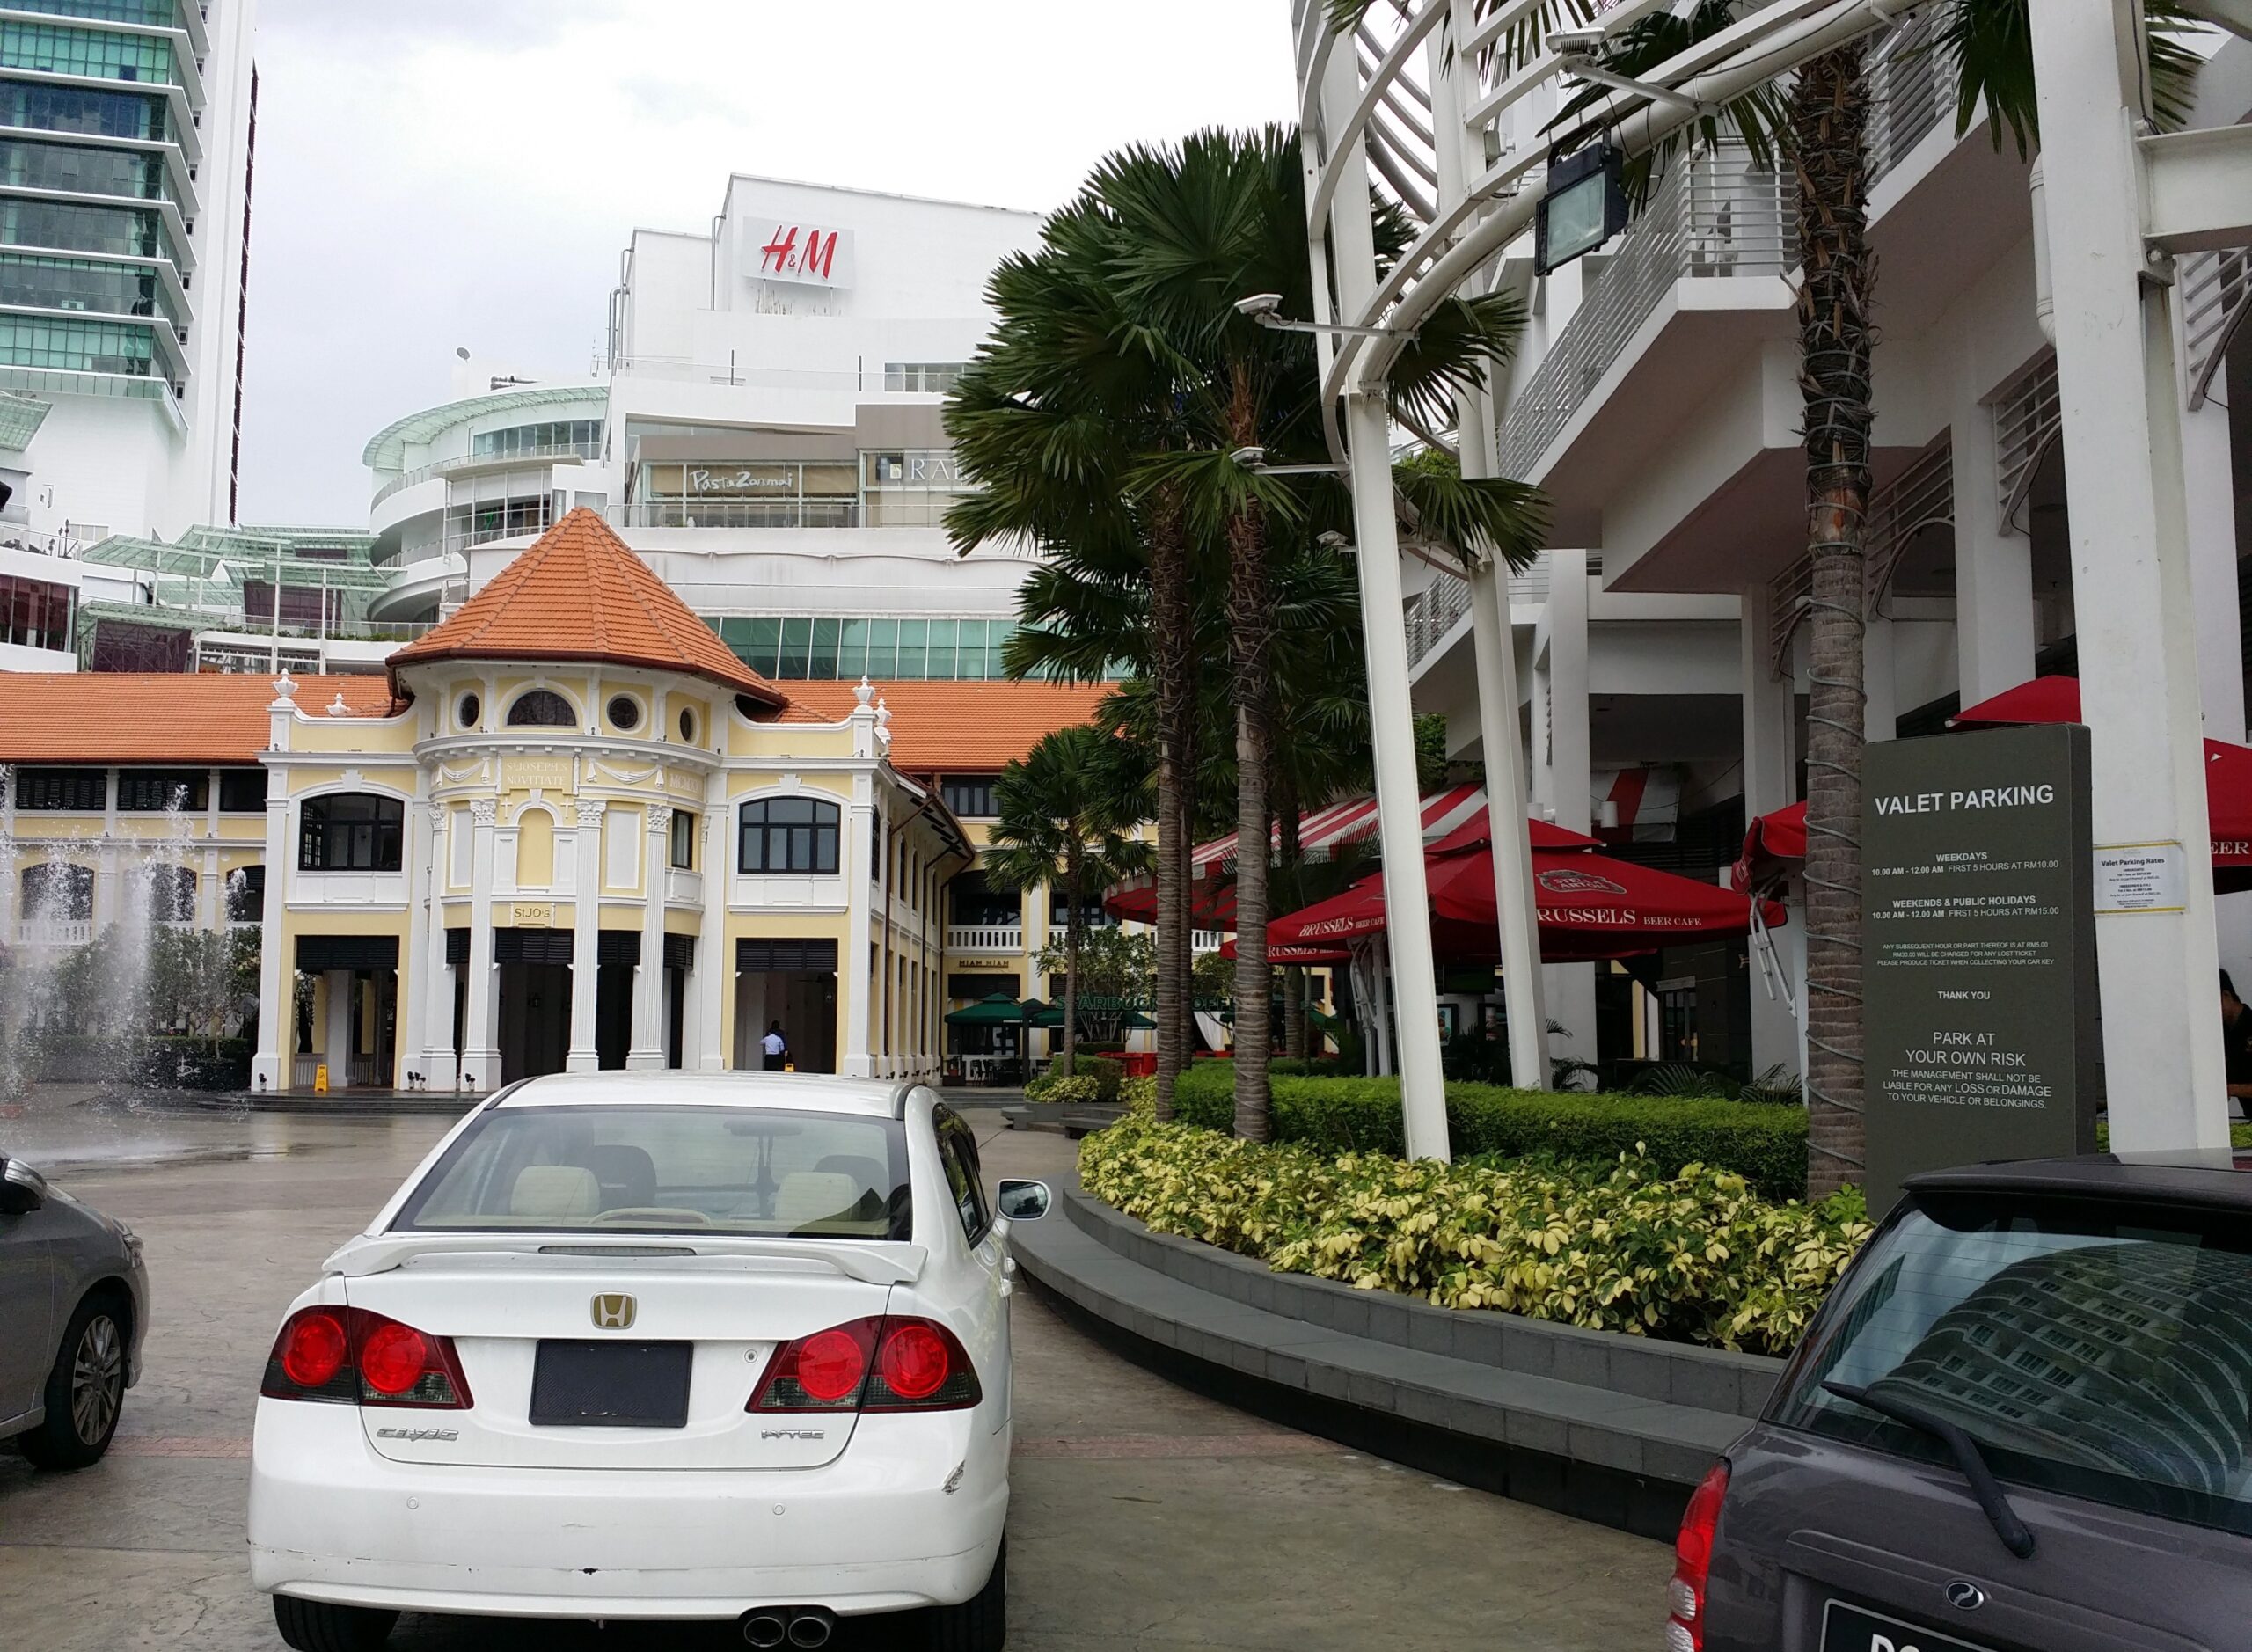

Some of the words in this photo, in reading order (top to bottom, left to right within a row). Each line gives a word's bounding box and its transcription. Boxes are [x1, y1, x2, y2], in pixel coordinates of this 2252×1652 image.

[760, 224, 838, 280] H&M
[507, 775, 567, 786] NOVITIATE
[1875, 793, 1944, 815] VALET
[1950, 784, 2054, 810] PARKING
[2210, 841, 2250, 854] EER
[1936, 852, 1988, 862] WEEKDAYS
[1872, 867, 1890, 876] 10.00
[1948, 864, 1971, 873] FIRST
[1979, 862, 2009, 871] HOURS
[2024, 860, 2059, 869] RM10.00
[1893, 898, 1942, 908] WEEKENDS
[1953, 897, 1986, 906] PUBLIC
[1988, 895, 2036, 905] HOLIDAYS
[1538, 908, 1636, 925] RUSSELS
[1643, 916, 1671, 925] BEER
[1673, 917, 1701, 925] CAFE
[1981, 908, 2009, 917] HOURS
[2025, 906, 2059, 915] RM15.00
[1298, 917, 1353, 937] BRUSSELS
[1267, 945, 1316, 957] RUSSELS
[1938, 990, 1969, 999] THANK
[1970, 990, 1991, 999] YOU
[1933, 1032, 1972, 1045] PARK
[1976, 1033, 1995, 1045] AT
[1905, 1050, 1947, 1063] YOUR
[1950, 1051, 1986, 1064] OWN
[1991, 1053, 2026, 1066] RISK
[1911, 1071, 1973, 1080] MANAGEMENT
[1976, 1072, 2004, 1082] SHALL
[2006, 1073, 2025, 1082] NOT
[1883, 1081, 1912, 1091] LIABLE
[1914, 1082, 1932, 1091] FOR
[1934, 1084, 1953, 1093] ANY
[1955, 1083, 1985, 1093] LOSS
[1986, 1085, 2000, 1094] OR
[2002, 1085, 2051, 1096] DAMAGE
[1900, 1093, 1927, 1103] YOUR
[1928, 1094, 1965, 1105] VEHICLE
[1967, 1096, 1981, 1105] OR
[1983, 1098, 2046, 1108] BELONGINGS.
[377, 1429, 459, 1442] CIVIC
